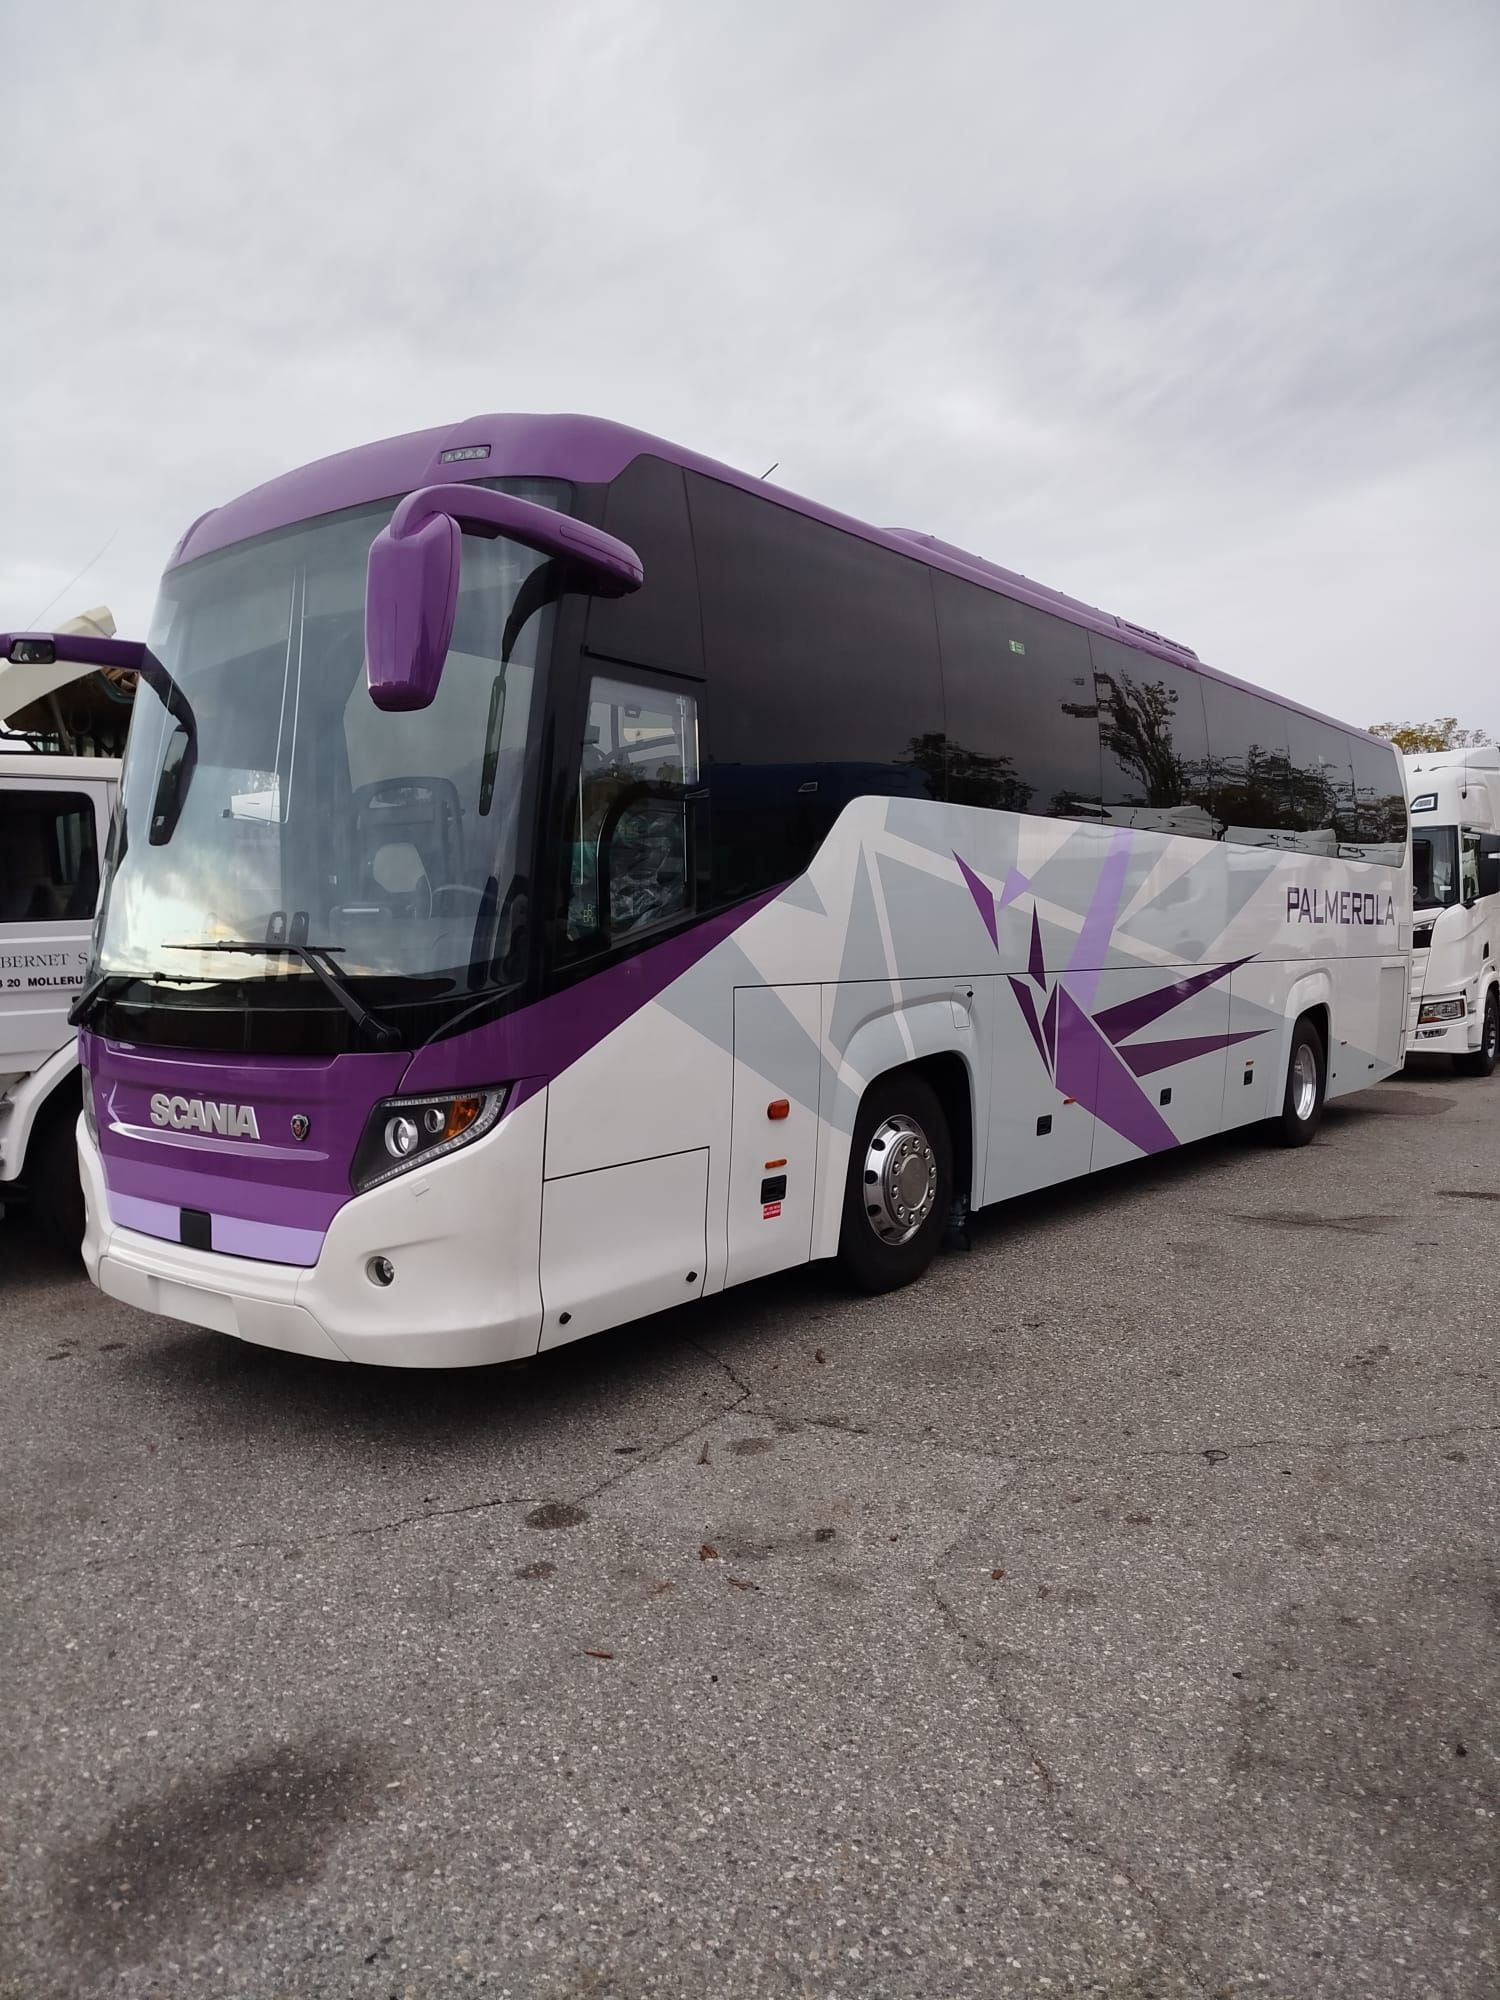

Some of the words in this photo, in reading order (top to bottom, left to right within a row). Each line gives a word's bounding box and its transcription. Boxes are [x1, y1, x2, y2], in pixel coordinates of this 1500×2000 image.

[1287, 886, 1395, 926] PALMEROLA
[7, 978, 21, 988] 20
[28, 975, 85, 987] MOLLERU
[150, 1093, 261, 1140] SCANIA
